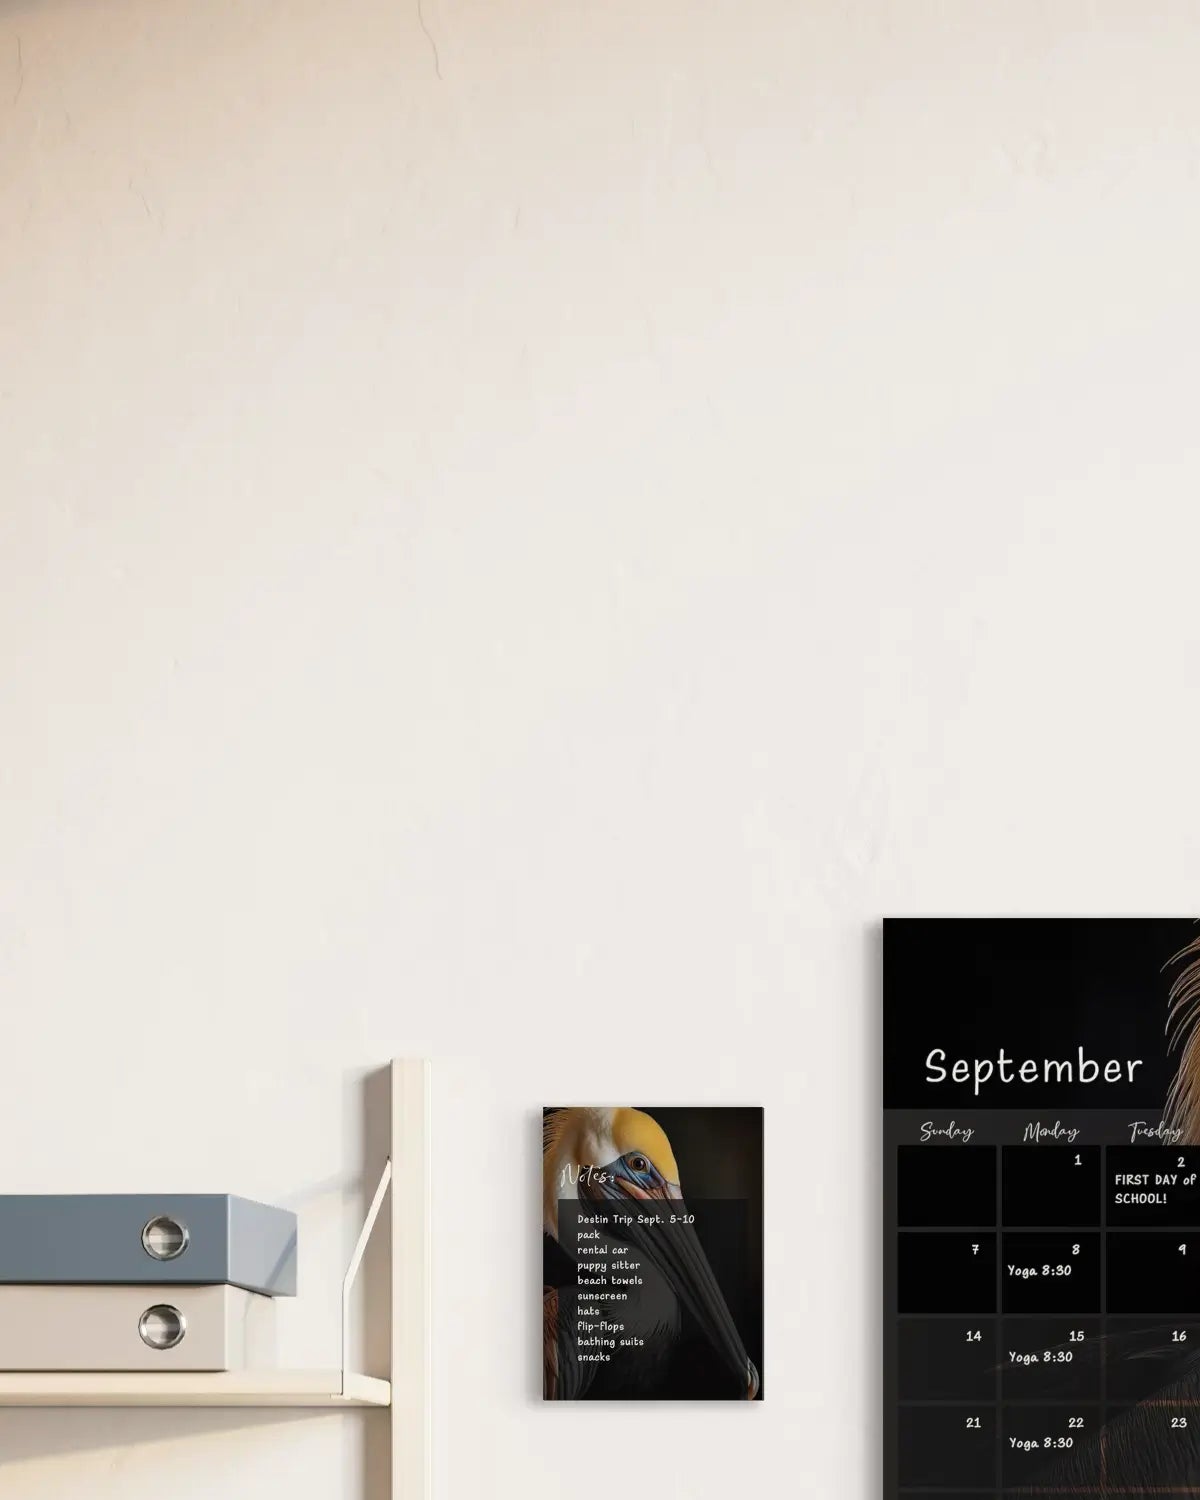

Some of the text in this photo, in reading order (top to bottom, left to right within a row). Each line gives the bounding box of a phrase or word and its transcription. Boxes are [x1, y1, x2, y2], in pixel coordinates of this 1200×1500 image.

[925, 1046, 1143, 1096] September
[920, 1121, 975, 1142] Sunday
[1023, 1122, 1080, 1142] Monday
[1128, 1121, 1184, 1142] Tuesday
[1074, 1155, 1082, 1166] 1
[1177, 1156, 1185, 1168] 2
[560, 1163, 615, 1188] Notes:
[1114, 1173, 1197, 1186] FIRST DAY of
[1114, 1192, 1167, 1204] SCHOOL!
[577, 1214, 694, 1227] Destin Trip Sept. 5-10
[577, 1230, 600, 1242] pack
[577, 1244, 628, 1254] rental car
[971, 1244, 980, 1255] 7
[1072, 1244, 1080, 1255] 8
[1178, 1244, 1187, 1255] 9
[577, 1260, 640, 1272] puppy sitter
[1007, 1265, 1072, 1278] Yoga 8:30
[577, 1275, 643, 1285] beach towels
[577, 1292, 628, 1300] sunscreen
[577, 1306, 600, 1316] hats
[577, 1321, 624, 1332] flip-flops
[577, 1336, 644, 1348] bathing suits
[966, 1331, 982, 1342] 14
[1069, 1331, 1085, 1342] 15
[1172, 1331, 1187, 1342] 16
[577, 1352, 611, 1362] snacks
[1009, 1351, 1073, 1365] Yoga 8:30
[966, 1417, 981, 1428] 21
[1068, 1417, 1084, 1428] 22
[1171, 1417, 1187, 1428] 23
[1009, 1438, 1073, 1451] Yoga 8:30
